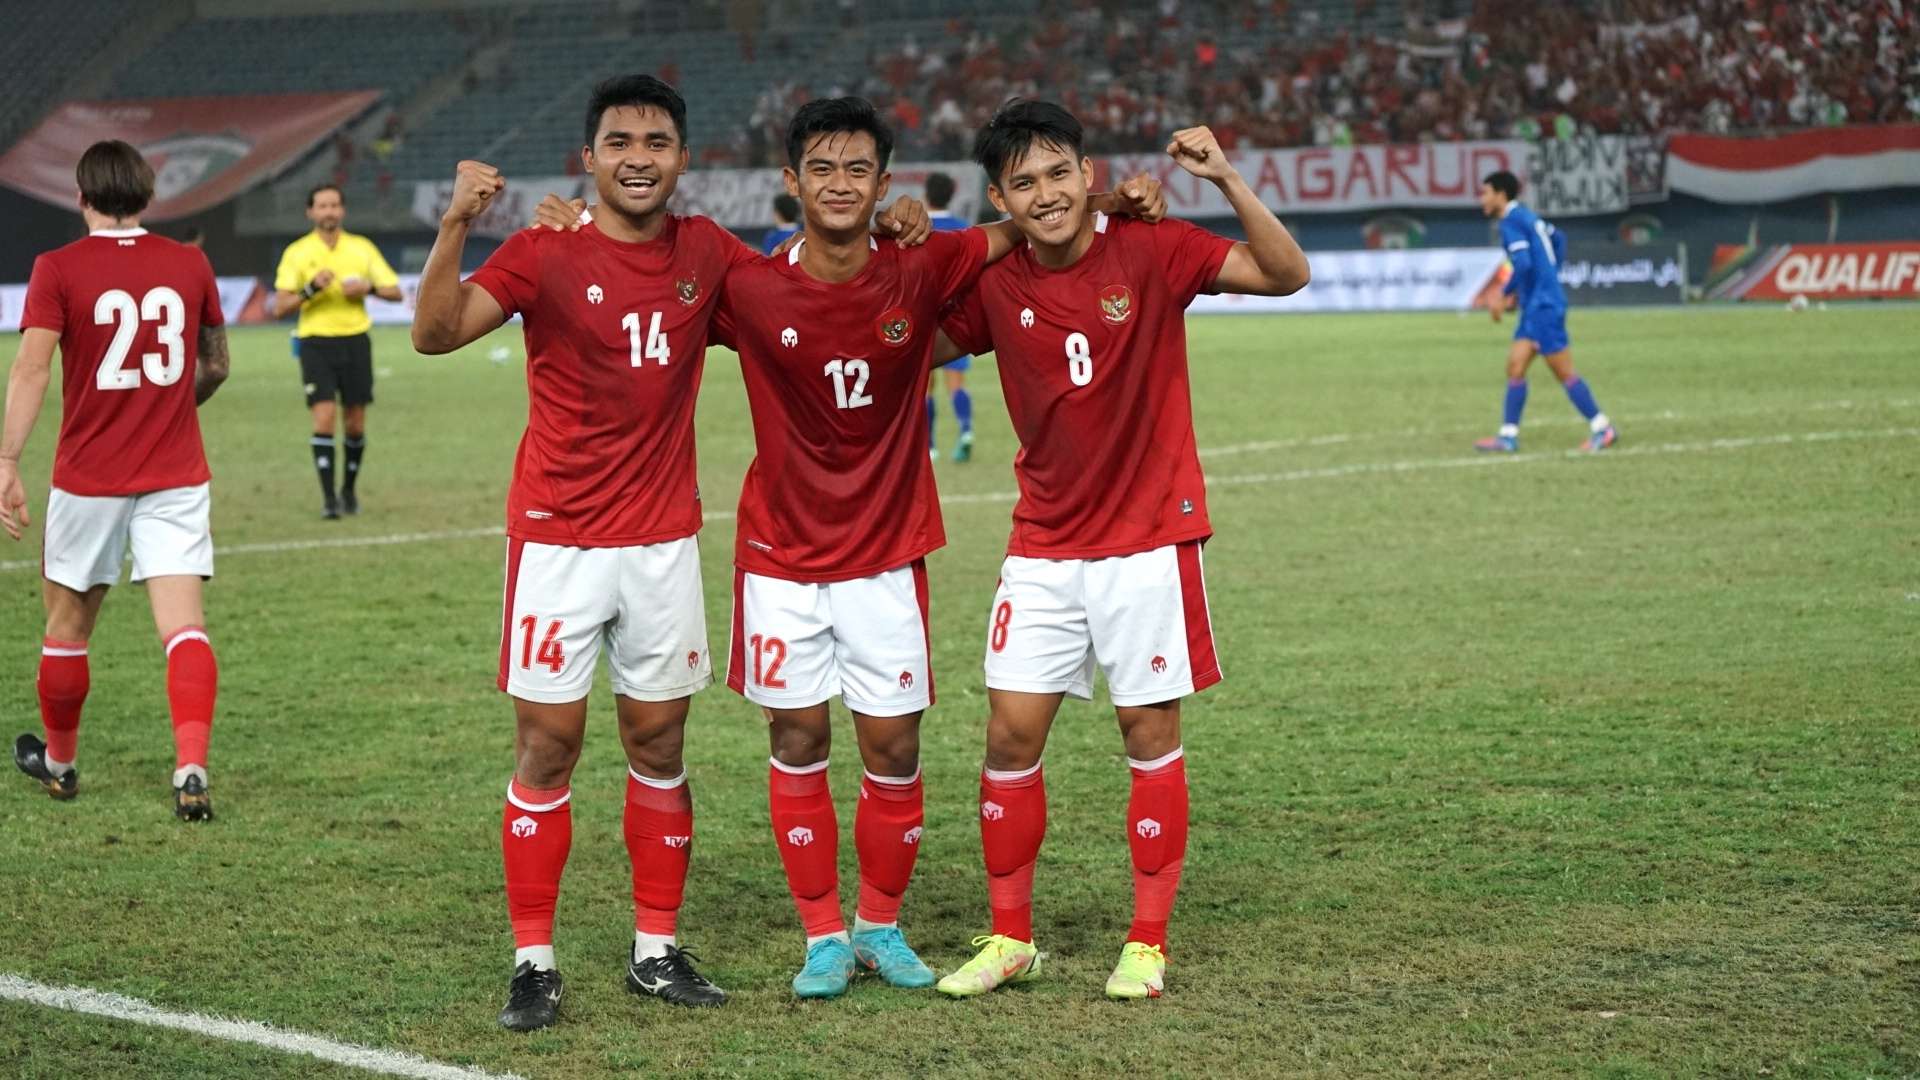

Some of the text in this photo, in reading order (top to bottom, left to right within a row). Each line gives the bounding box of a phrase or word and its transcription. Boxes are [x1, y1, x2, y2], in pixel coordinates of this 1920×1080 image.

[94, 286, 185, 390] 23
[621, 311, 671, 367] 14
[1065, 332, 1093, 386] 8
[824, 358, 873, 409] 12
[519, 614, 566, 673] 14
[991, 600, 1013, 653] 8
[750, 633, 788, 690] 12
